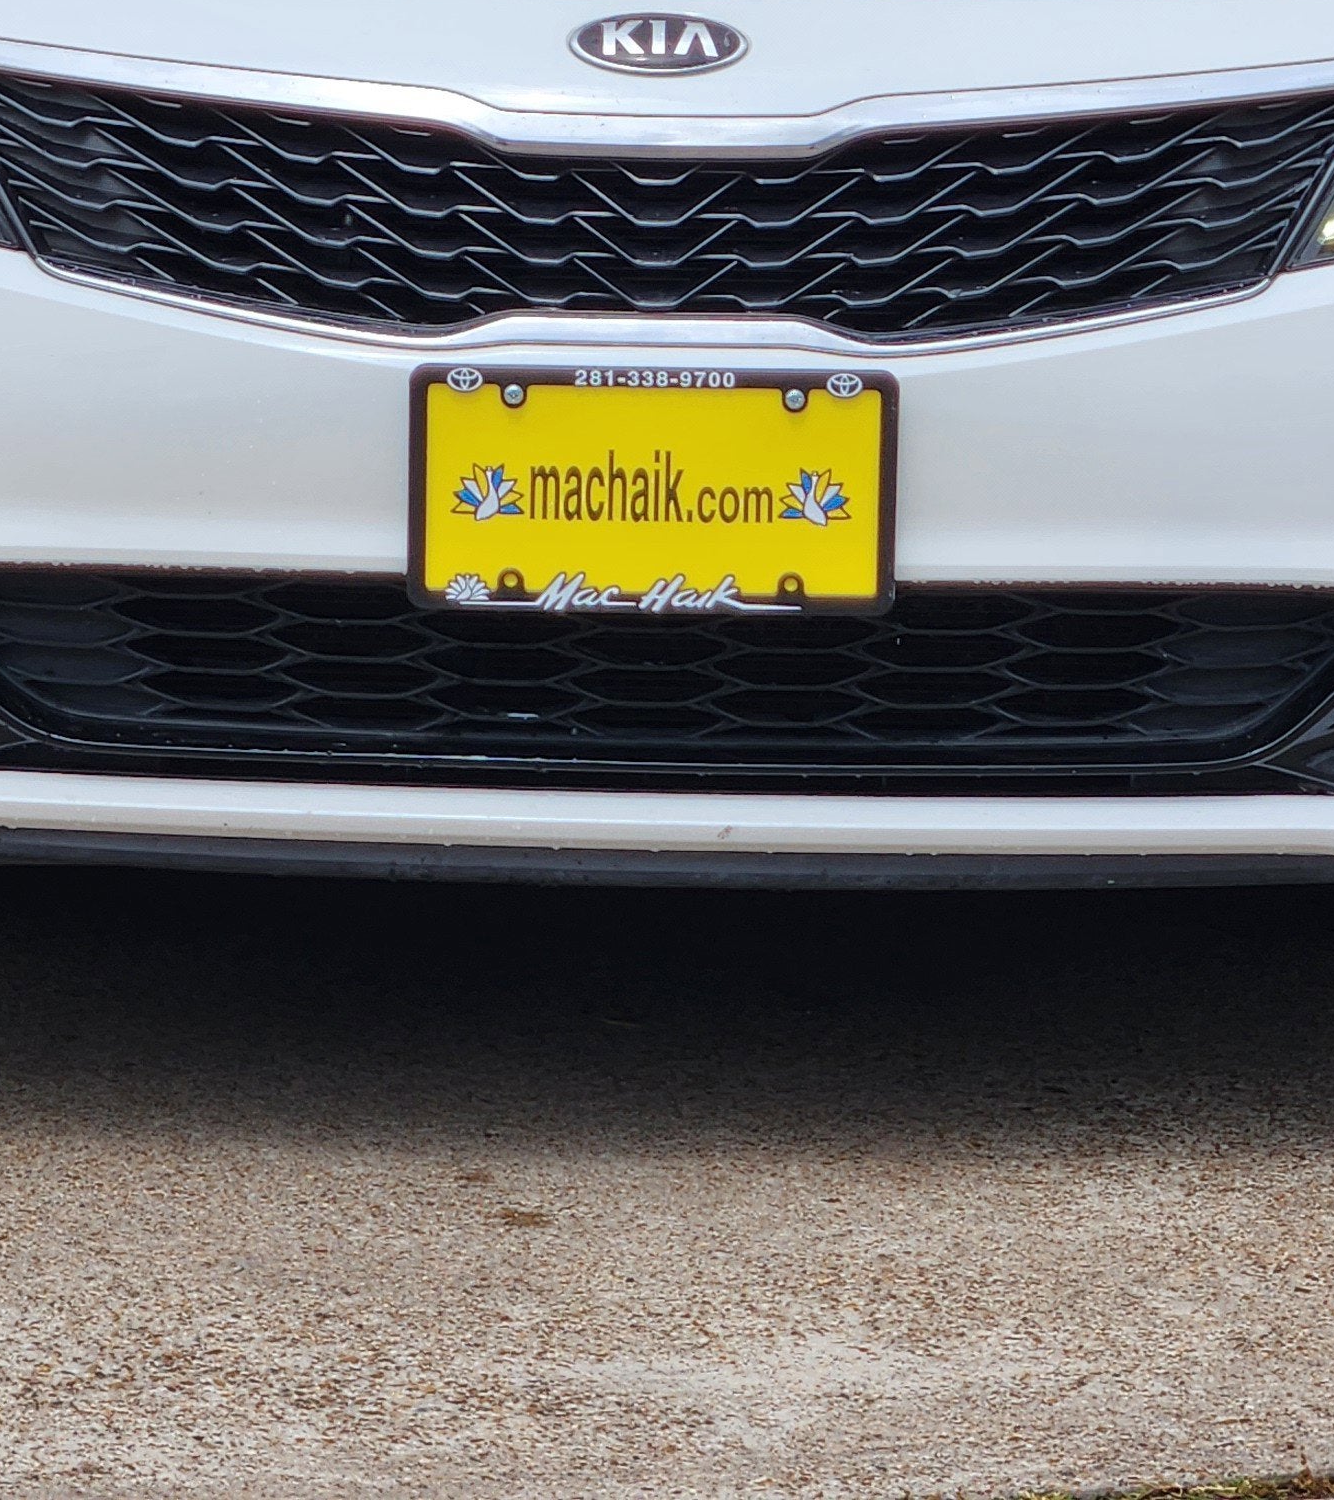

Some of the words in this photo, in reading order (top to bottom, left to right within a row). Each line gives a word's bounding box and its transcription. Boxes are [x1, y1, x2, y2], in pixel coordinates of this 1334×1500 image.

[601, 19, 719, 58] KIA
[573, 369, 736, 390] 281-338-9700
[529, 449, 774, 525] machaik.com
[537, 571, 631, 611] Mac
